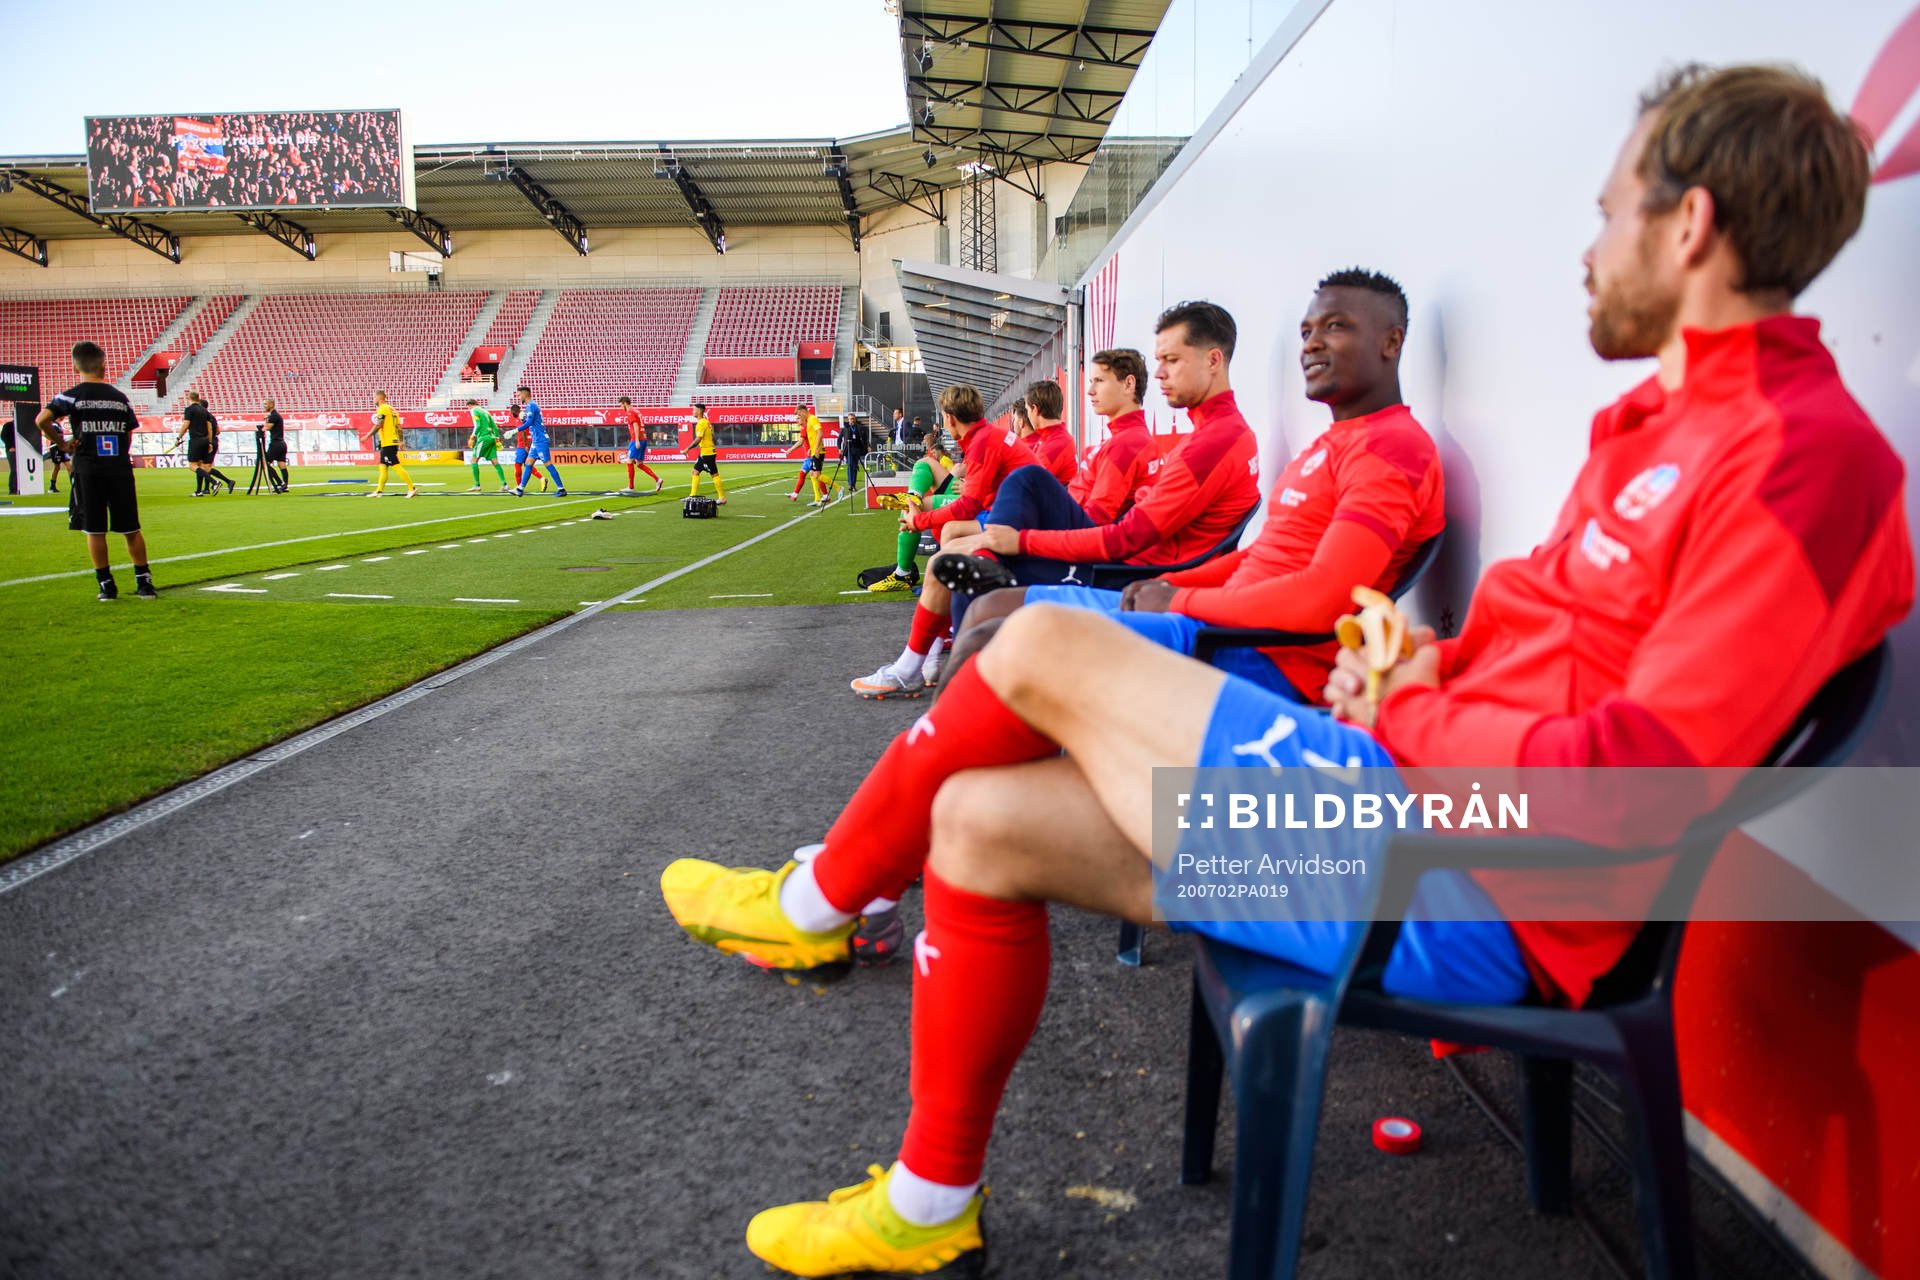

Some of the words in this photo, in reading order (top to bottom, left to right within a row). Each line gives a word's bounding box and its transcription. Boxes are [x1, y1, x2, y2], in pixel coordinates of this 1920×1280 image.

[232, 134, 264, 145] röda
[268, 135, 292, 145] och
[425, 413, 458, 425] Carlsberg
[82, 420, 126, 433] BOLLKALLE
[554, 452, 579, 464] min
[580, 452, 615, 465] cykel
[27, 458, 36, 474] U
